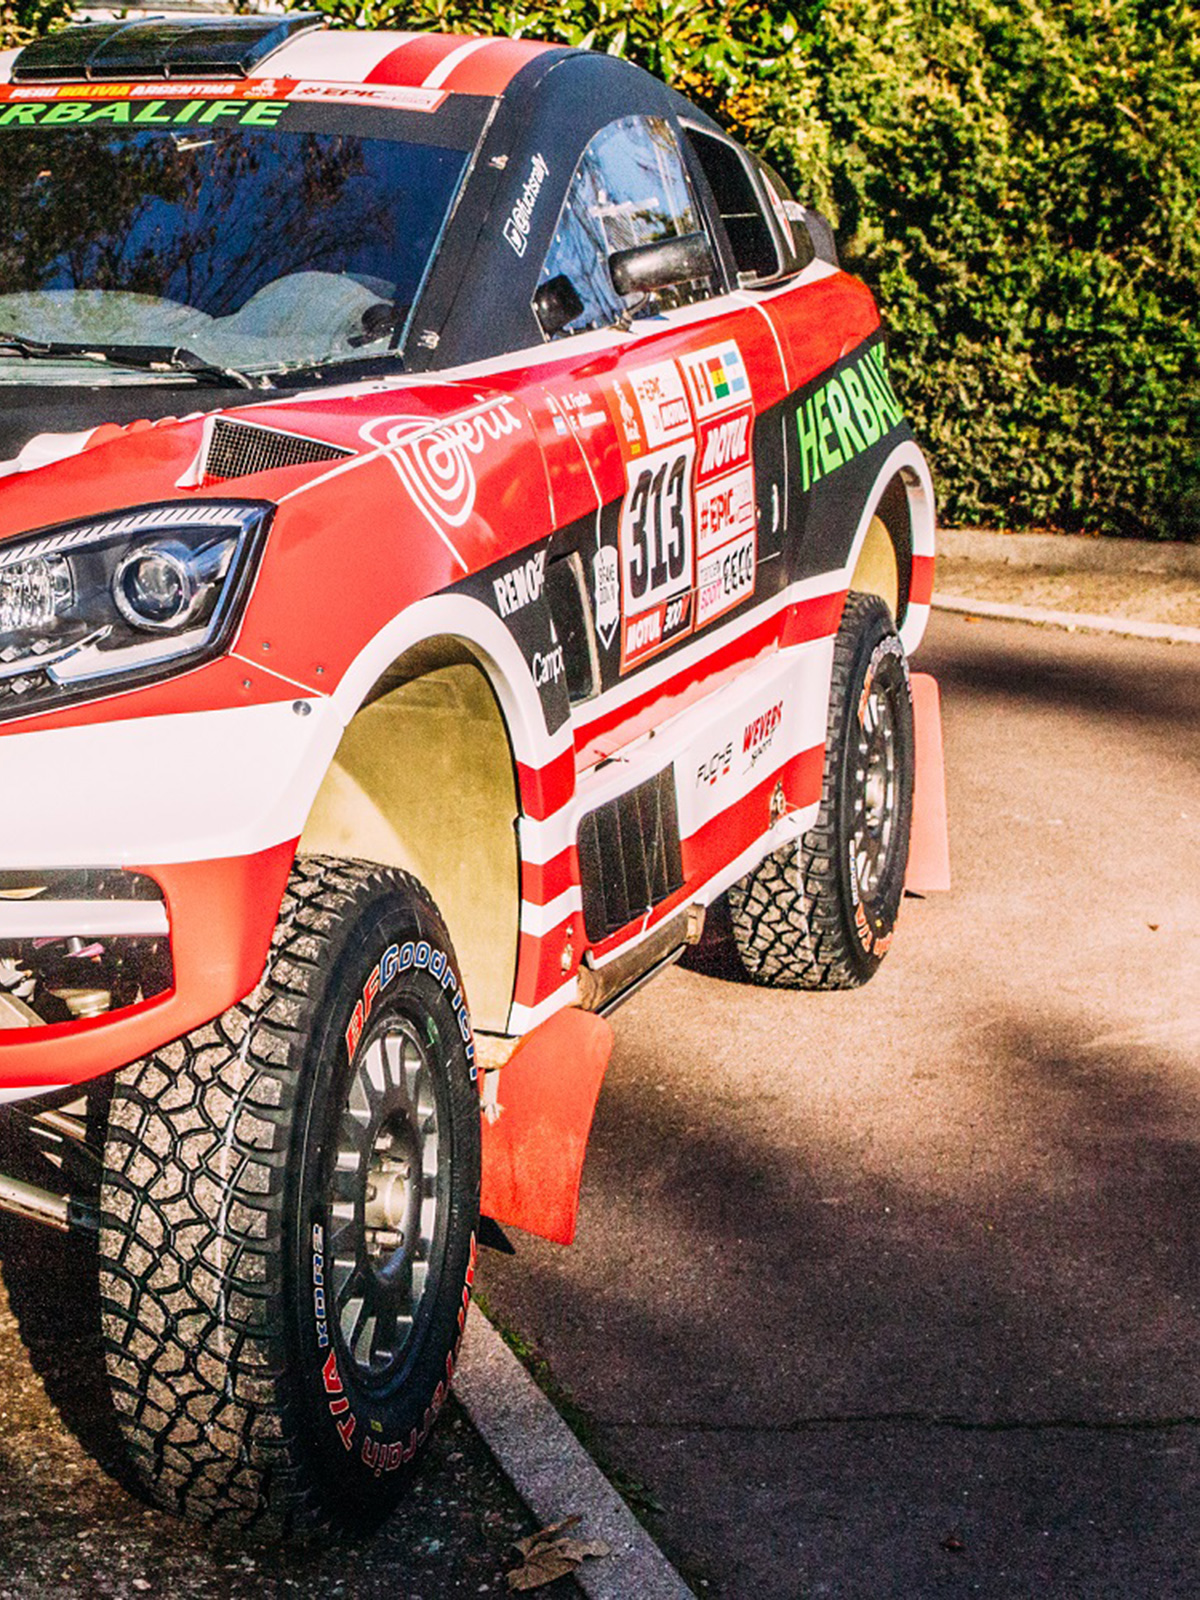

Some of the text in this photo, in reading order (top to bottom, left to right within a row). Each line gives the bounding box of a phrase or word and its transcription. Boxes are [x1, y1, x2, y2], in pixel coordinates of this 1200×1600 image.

[56, 86, 130, 97] BOLIVIA
[129, 85, 236, 97] ARGENTINA
[701, 415, 750, 474] MOTUL
[629, 455, 688, 599] 313
[626, 610, 661, 655] MOTUL
